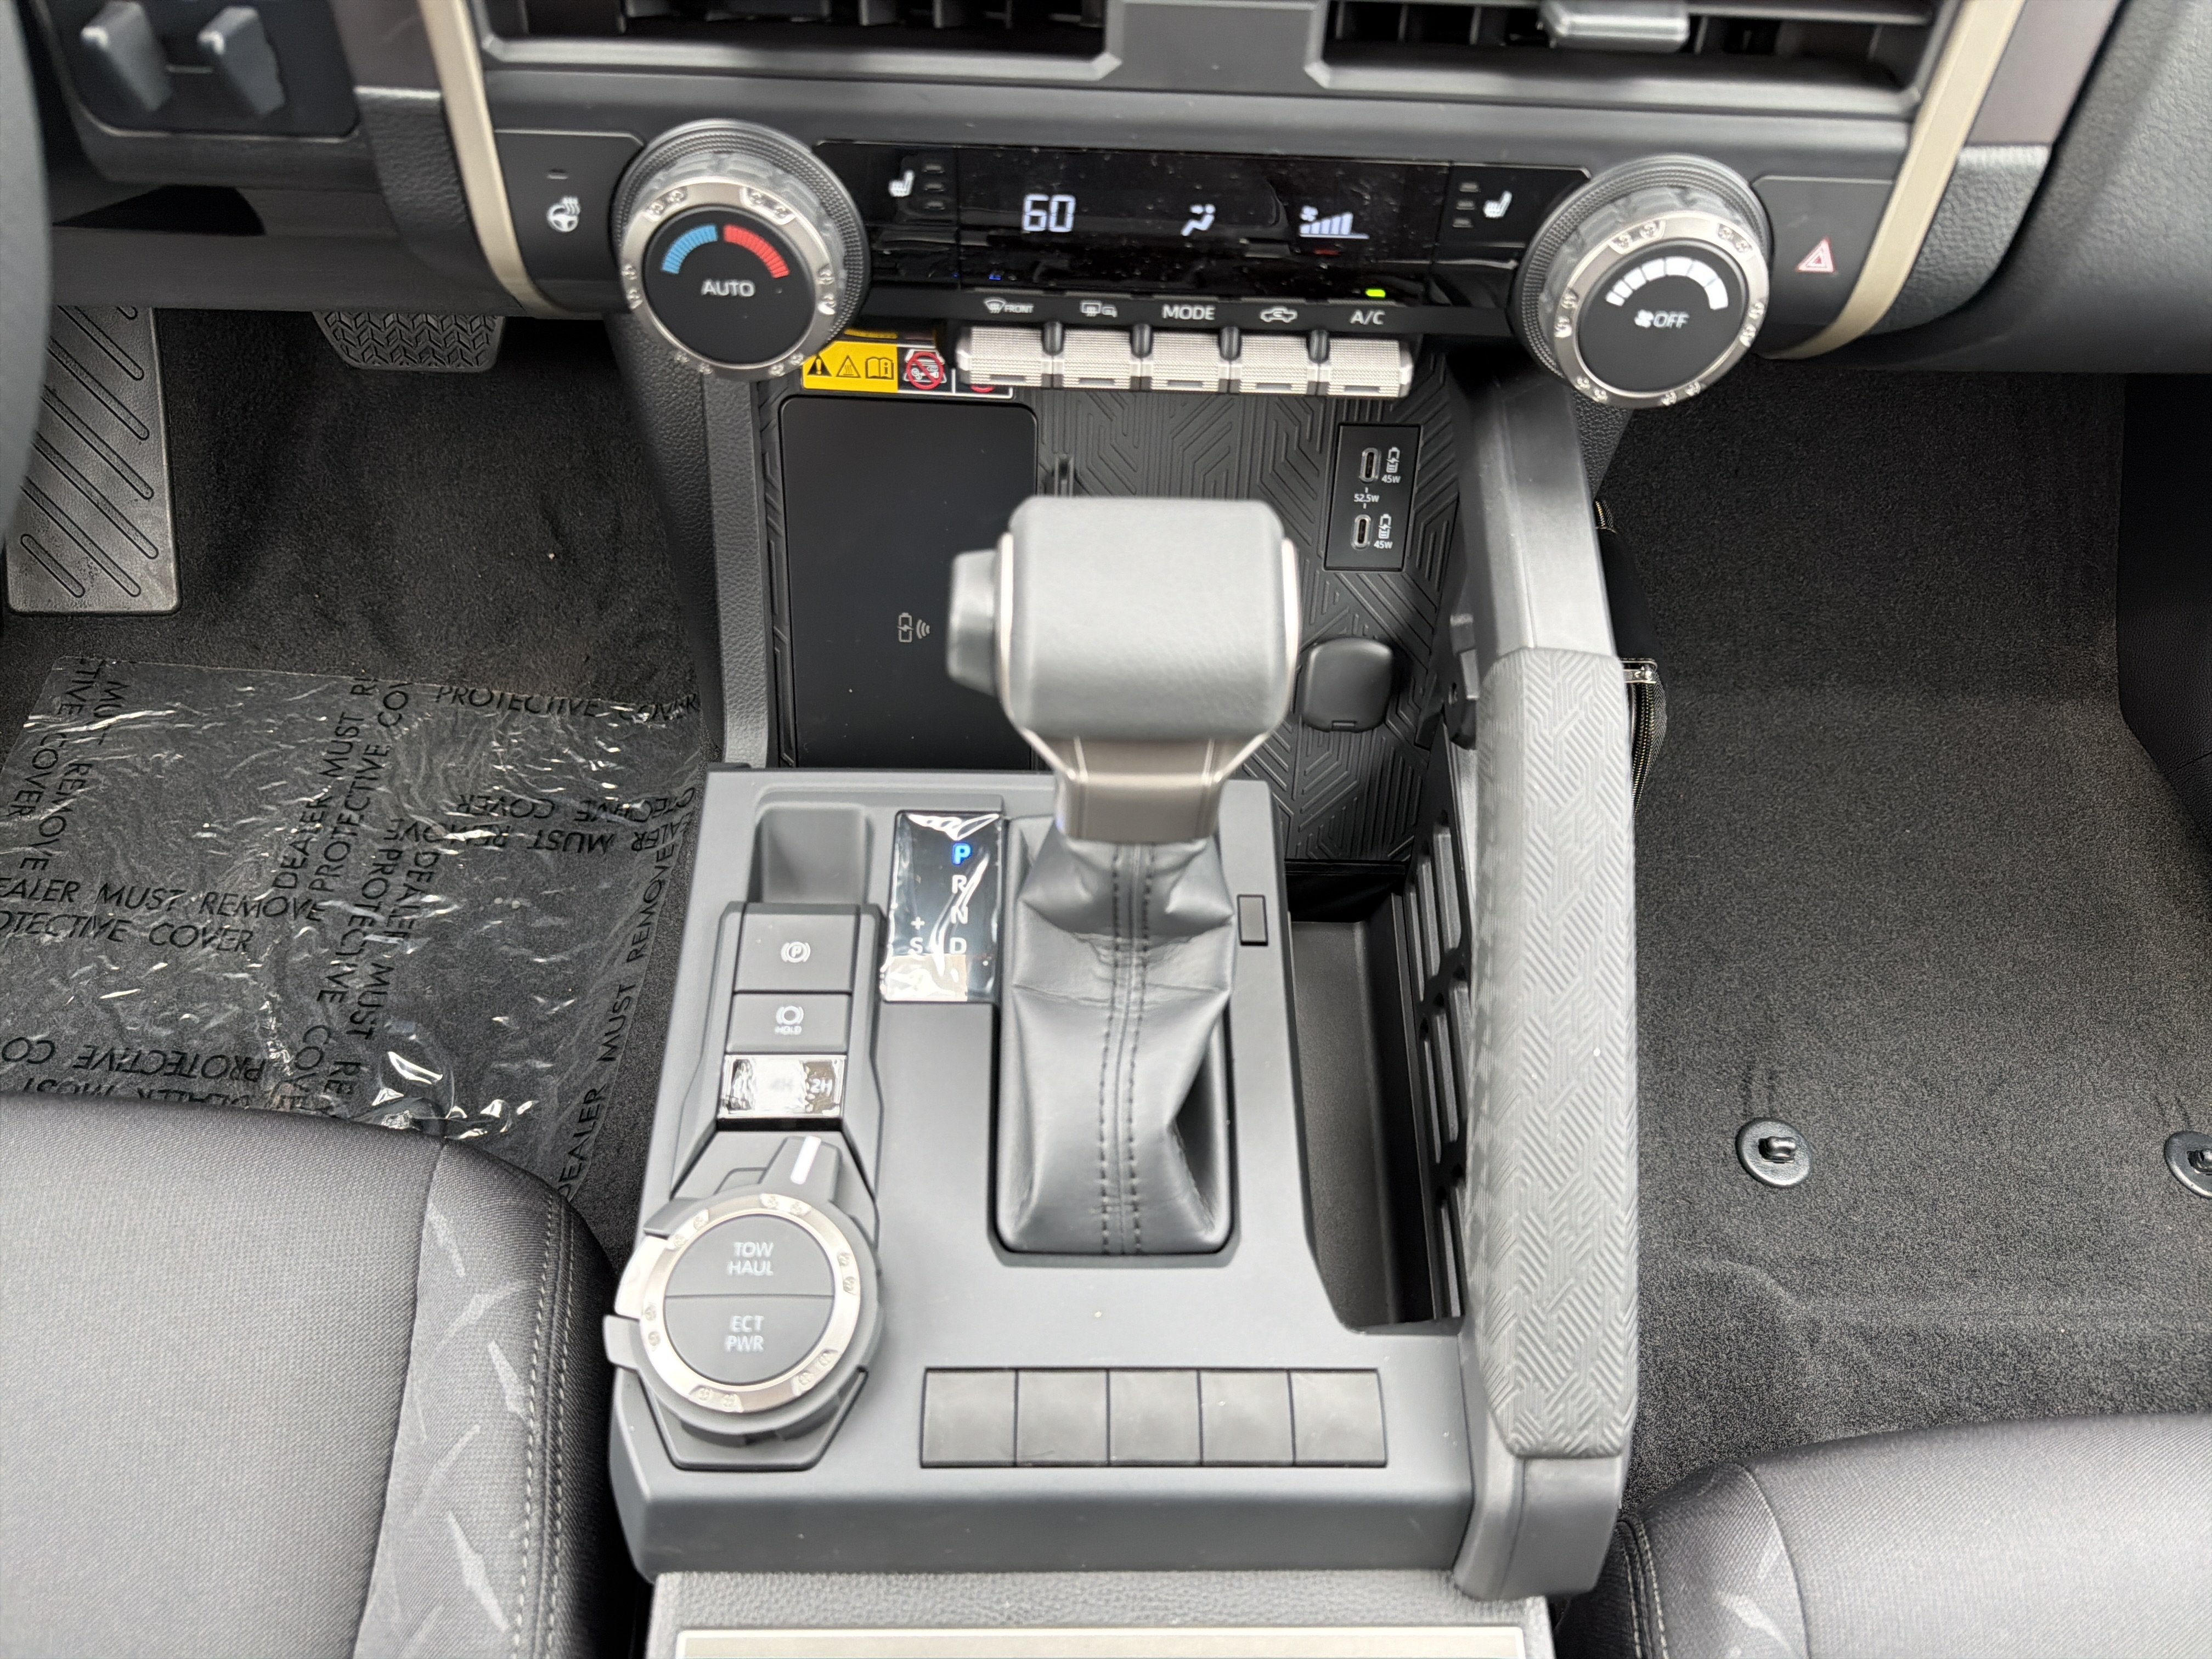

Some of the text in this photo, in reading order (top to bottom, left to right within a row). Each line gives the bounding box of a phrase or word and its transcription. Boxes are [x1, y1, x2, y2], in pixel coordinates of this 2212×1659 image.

[1022, 194, 1076, 233] 60
[701, 280, 755, 297] AUTO
[1004, 303, 1034, 314] FRONT
[1163, 304, 1215, 321] MODE
[1351, 310, 1384, 325] A/C
[1653, 312, 1690, 329] OFF
[1381, 475, 1401, 483] 45W
[1353, 494, 1380, 503] 52.5W
[1374, 541, 1393, 549] 45W
[58, 658, 105, 715] TIVE
[321, 713, 364, 777] MUST
[308, 743, 390, 892] PROTECTIVE
[527, 828, 614, 855] MUST
[952, 843, 972, 866] P
[952, 874, 967, 894] R
[94, 882, 187, 911] MUST
[950, 906, 968, 924] N
[149, 923, 255, 953] COVER
[910, 937, 967, 954] S D
[597, 985, 635, 1062] MUST
[627, 844, 674, 963] REMOVE
[346, 963, 394, 1040] MUST
[774, 1025, 802, 1035] HOLD
[74, 1043, 266, 1082] PROTECTIVE
[810, 1078, 833, 1097] 2H
[734, 1242, 774, 1256] TOW
[727, 1261, 774, 1276] HAUL
[730, 1316, 764, 1332] ECT
[725, 1335, 764, 1352] PWR
